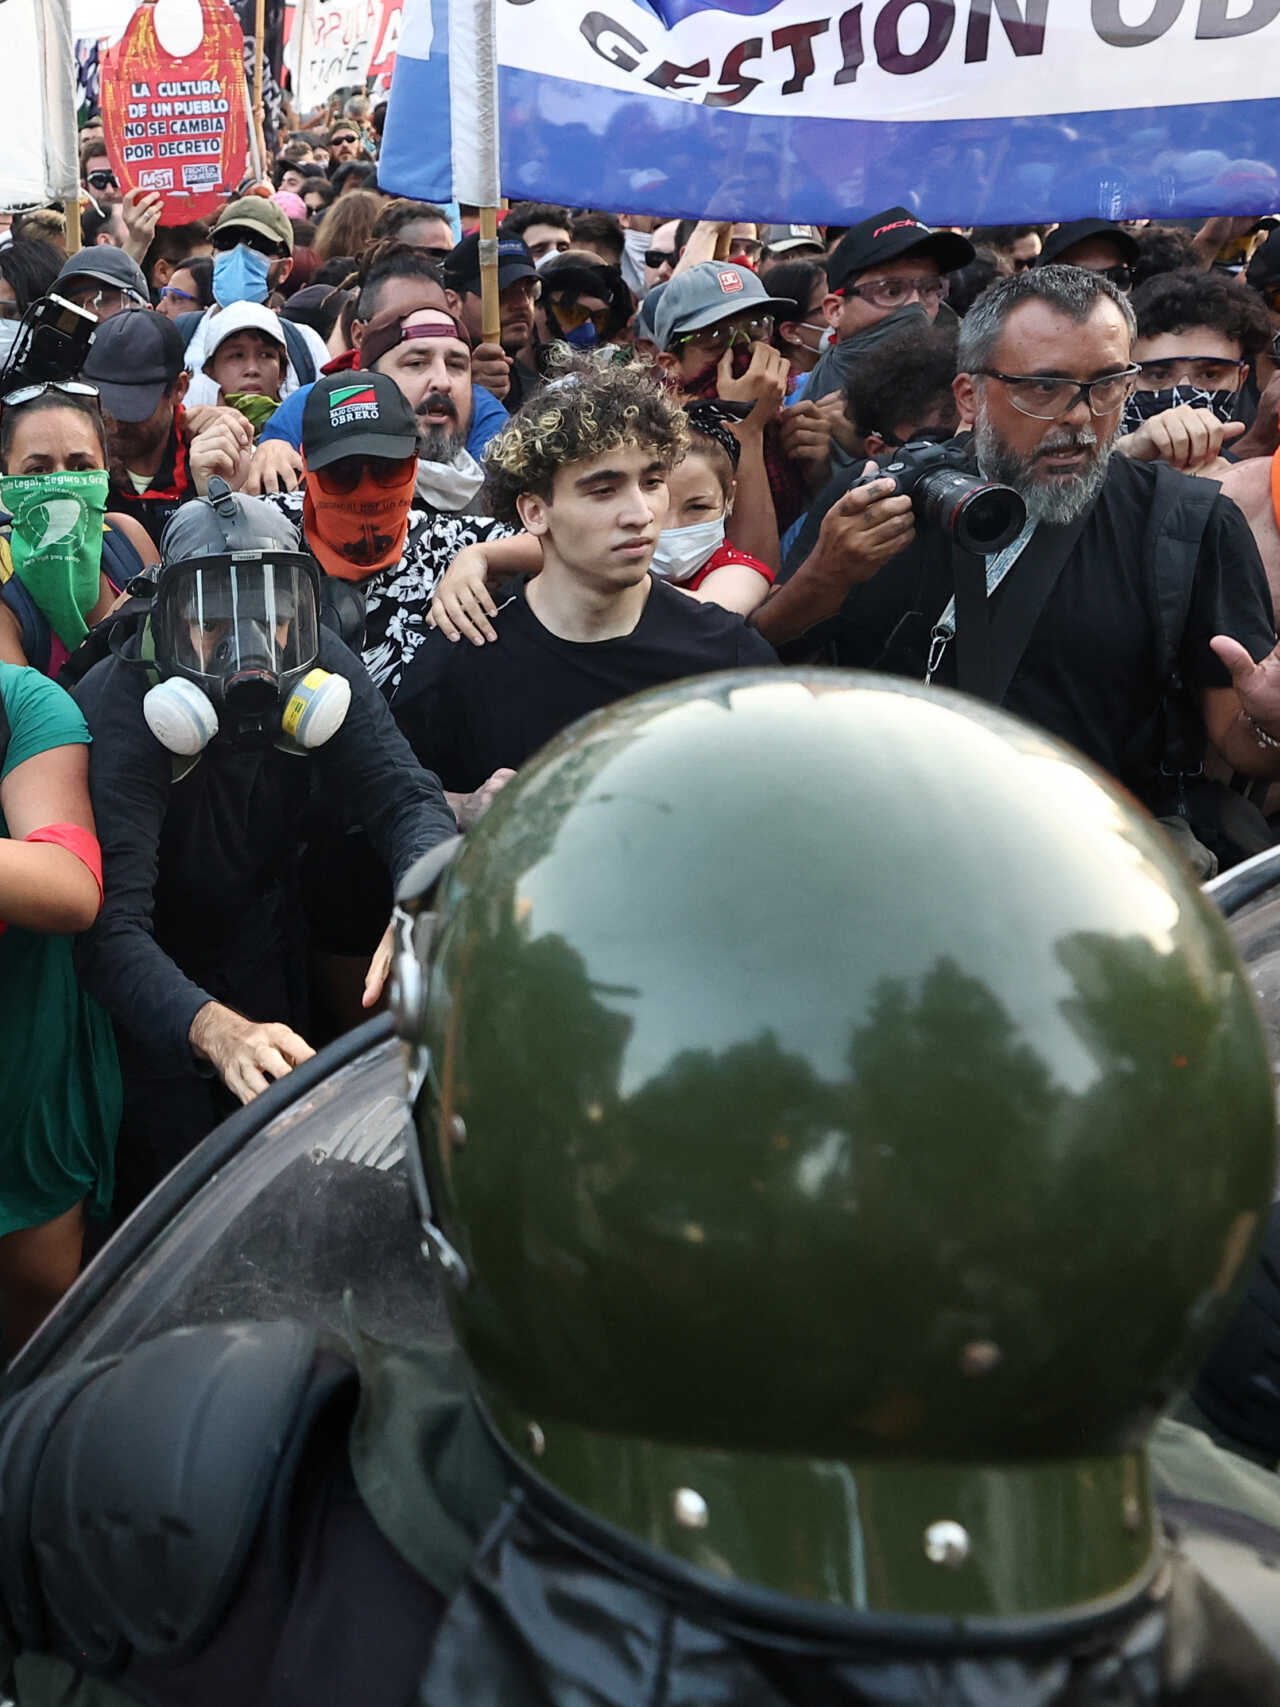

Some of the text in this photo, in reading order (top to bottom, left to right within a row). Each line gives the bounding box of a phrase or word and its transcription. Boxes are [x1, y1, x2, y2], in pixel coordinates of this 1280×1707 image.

[579, 0, 1045, 107] GESTION
[131, 80, 222, 98] LA CULTURA
[128, 98, 229, 118] DE UN PUEBLO
[124, 118, 224, 137] NO SE CAMBIA
[124, 138, 220, 160] POR DECRETO
[331, 409, 380, 427] OBRERO
[14, 478, 42, 490] Legal,
[43, 474, 81, 486] Seguro
